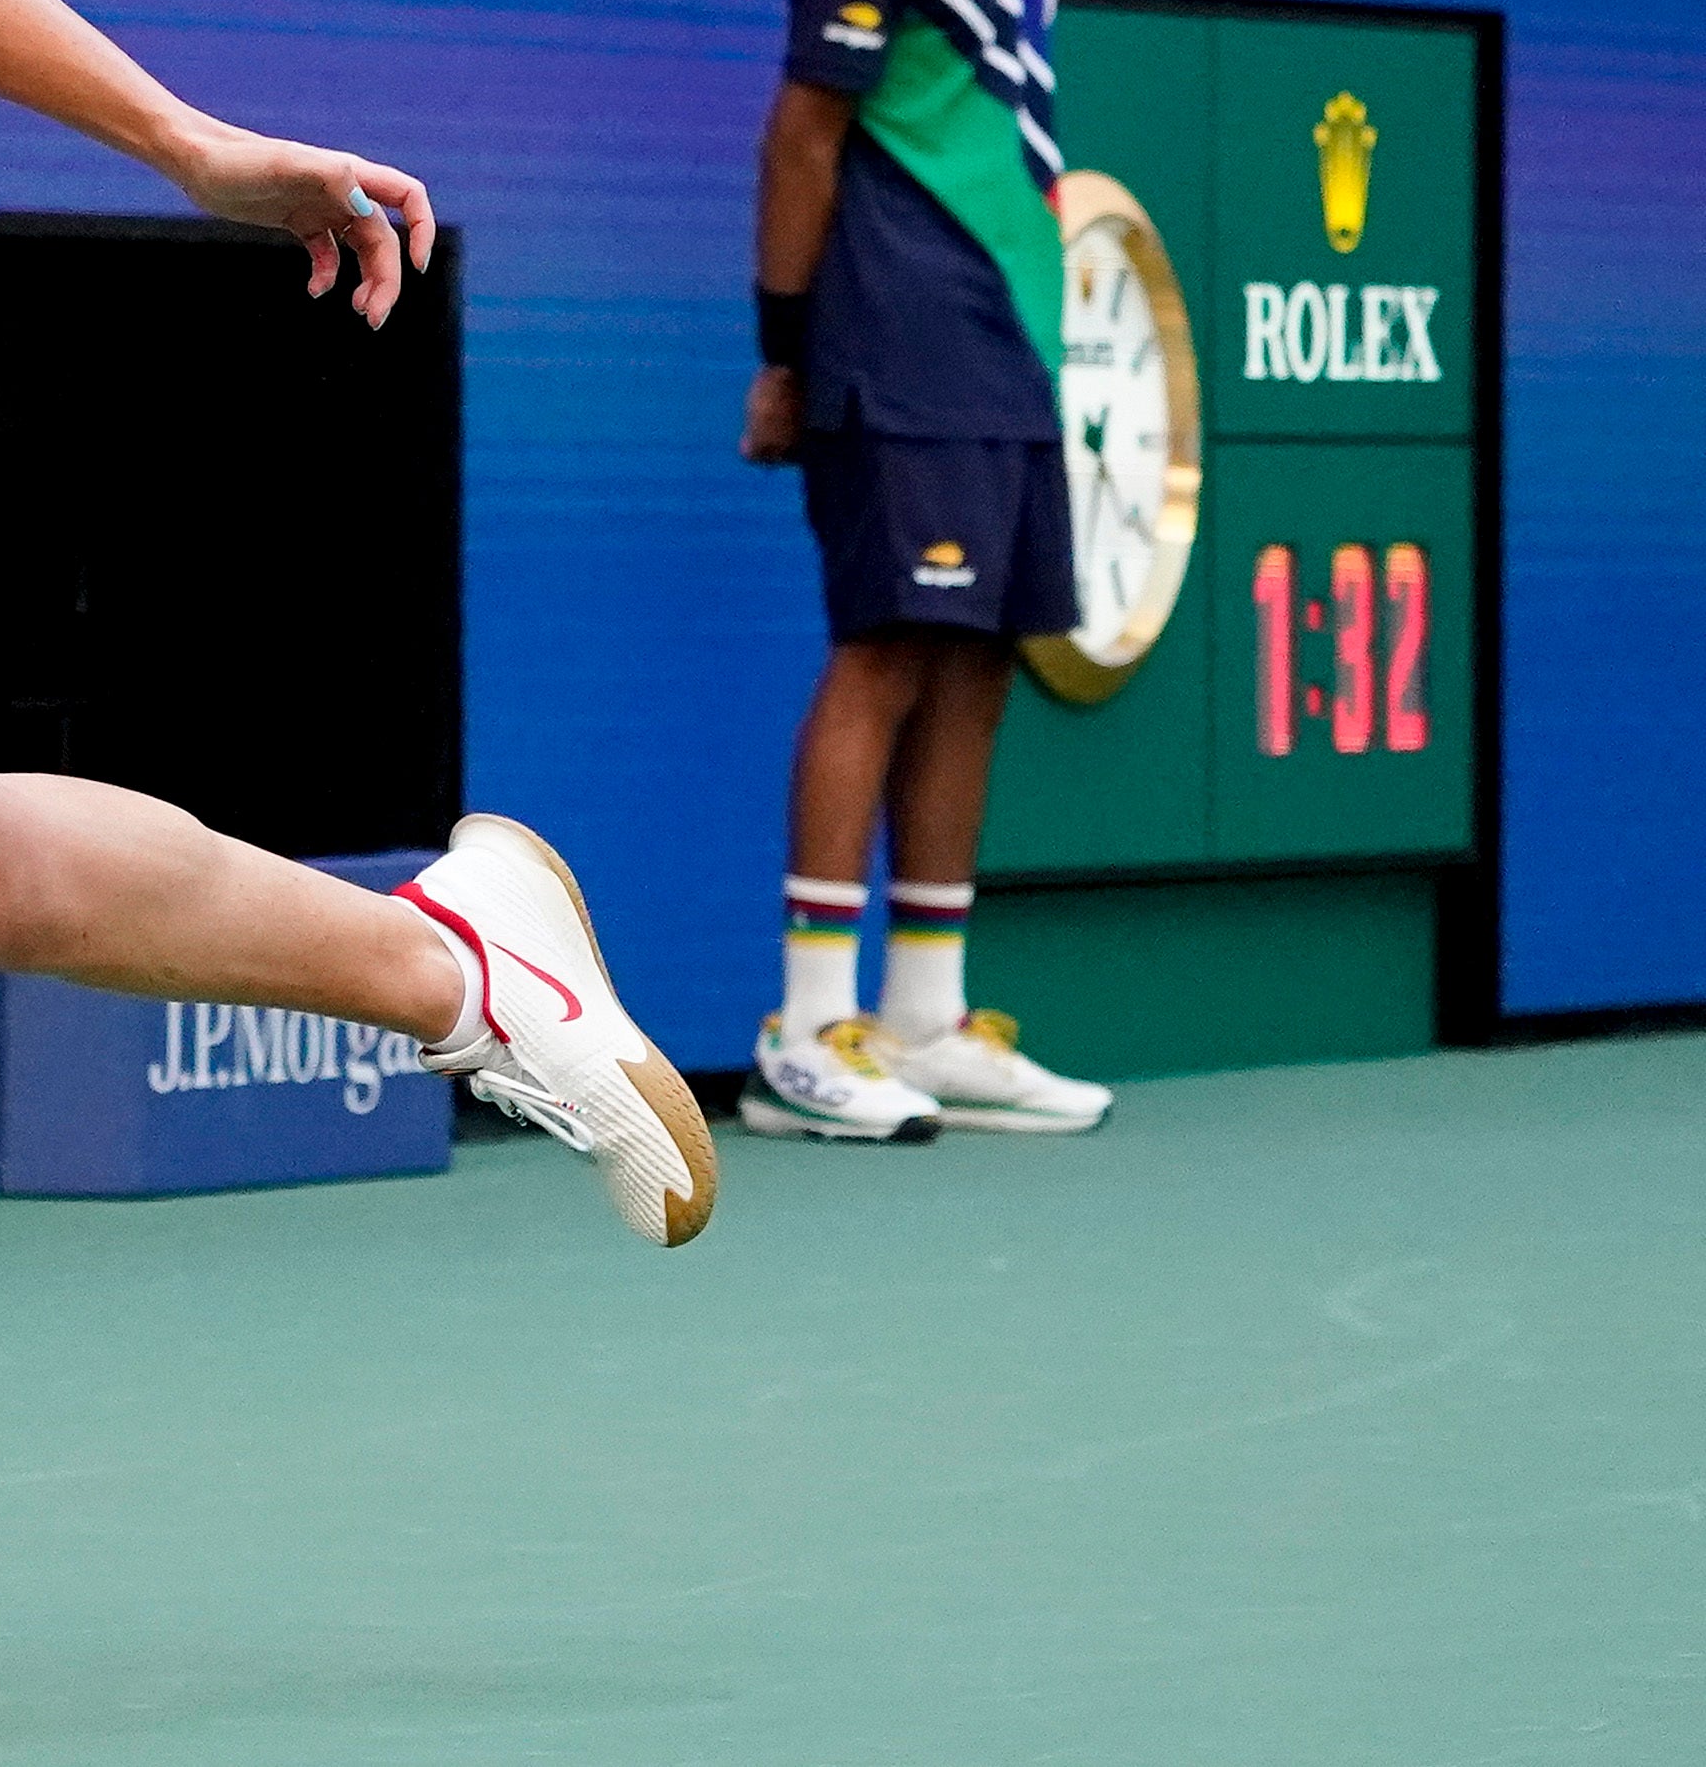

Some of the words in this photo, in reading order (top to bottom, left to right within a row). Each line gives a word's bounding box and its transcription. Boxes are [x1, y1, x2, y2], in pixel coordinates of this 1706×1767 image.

[1243, 280, 1443, 383] ROLEX
[1253, 542, 1429, 757] 1:32
[147, 1000, 428, 1116] J.P.Morga
